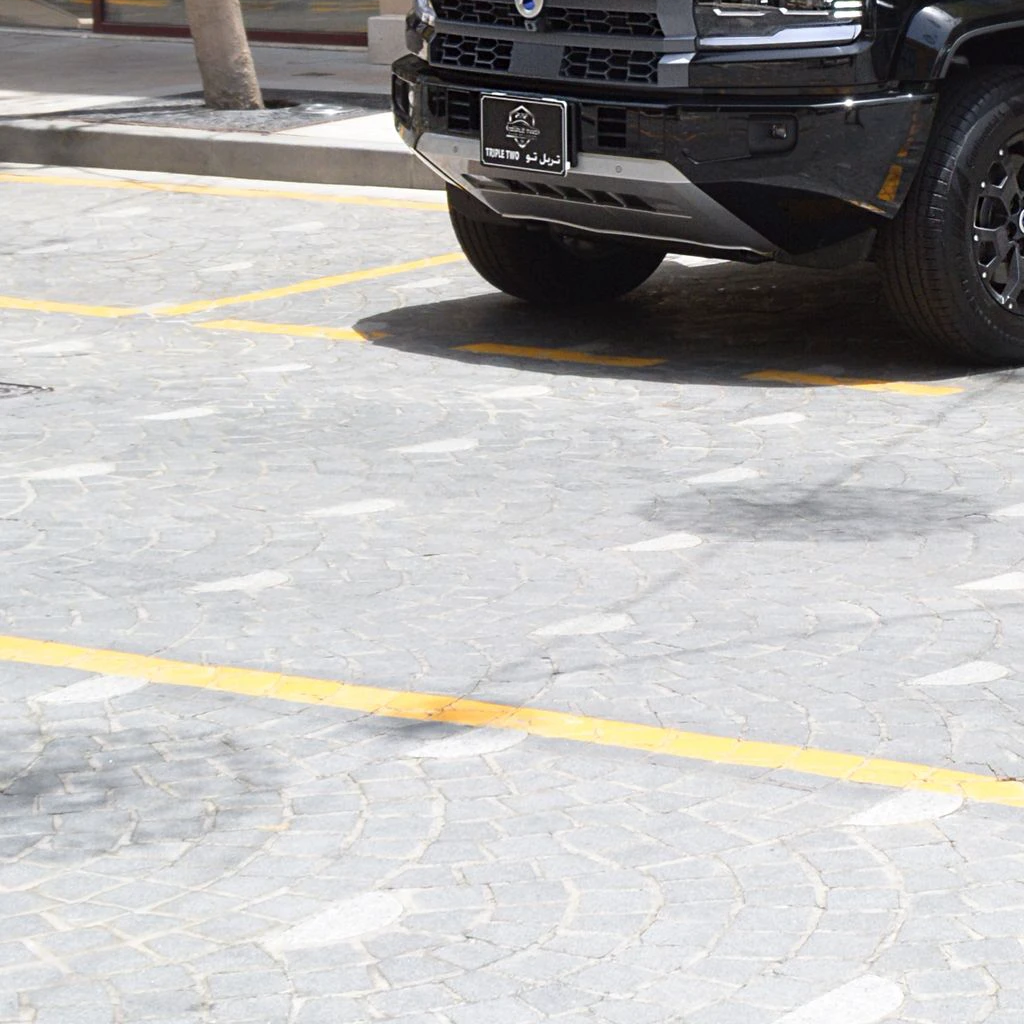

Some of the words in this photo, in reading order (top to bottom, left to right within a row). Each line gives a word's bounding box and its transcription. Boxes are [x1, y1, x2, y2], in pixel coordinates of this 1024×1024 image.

[485, 147, 505, 159] TRIPLE
[505, 149, 520, 161] TWO
[525, 151, 538, 163] تو
